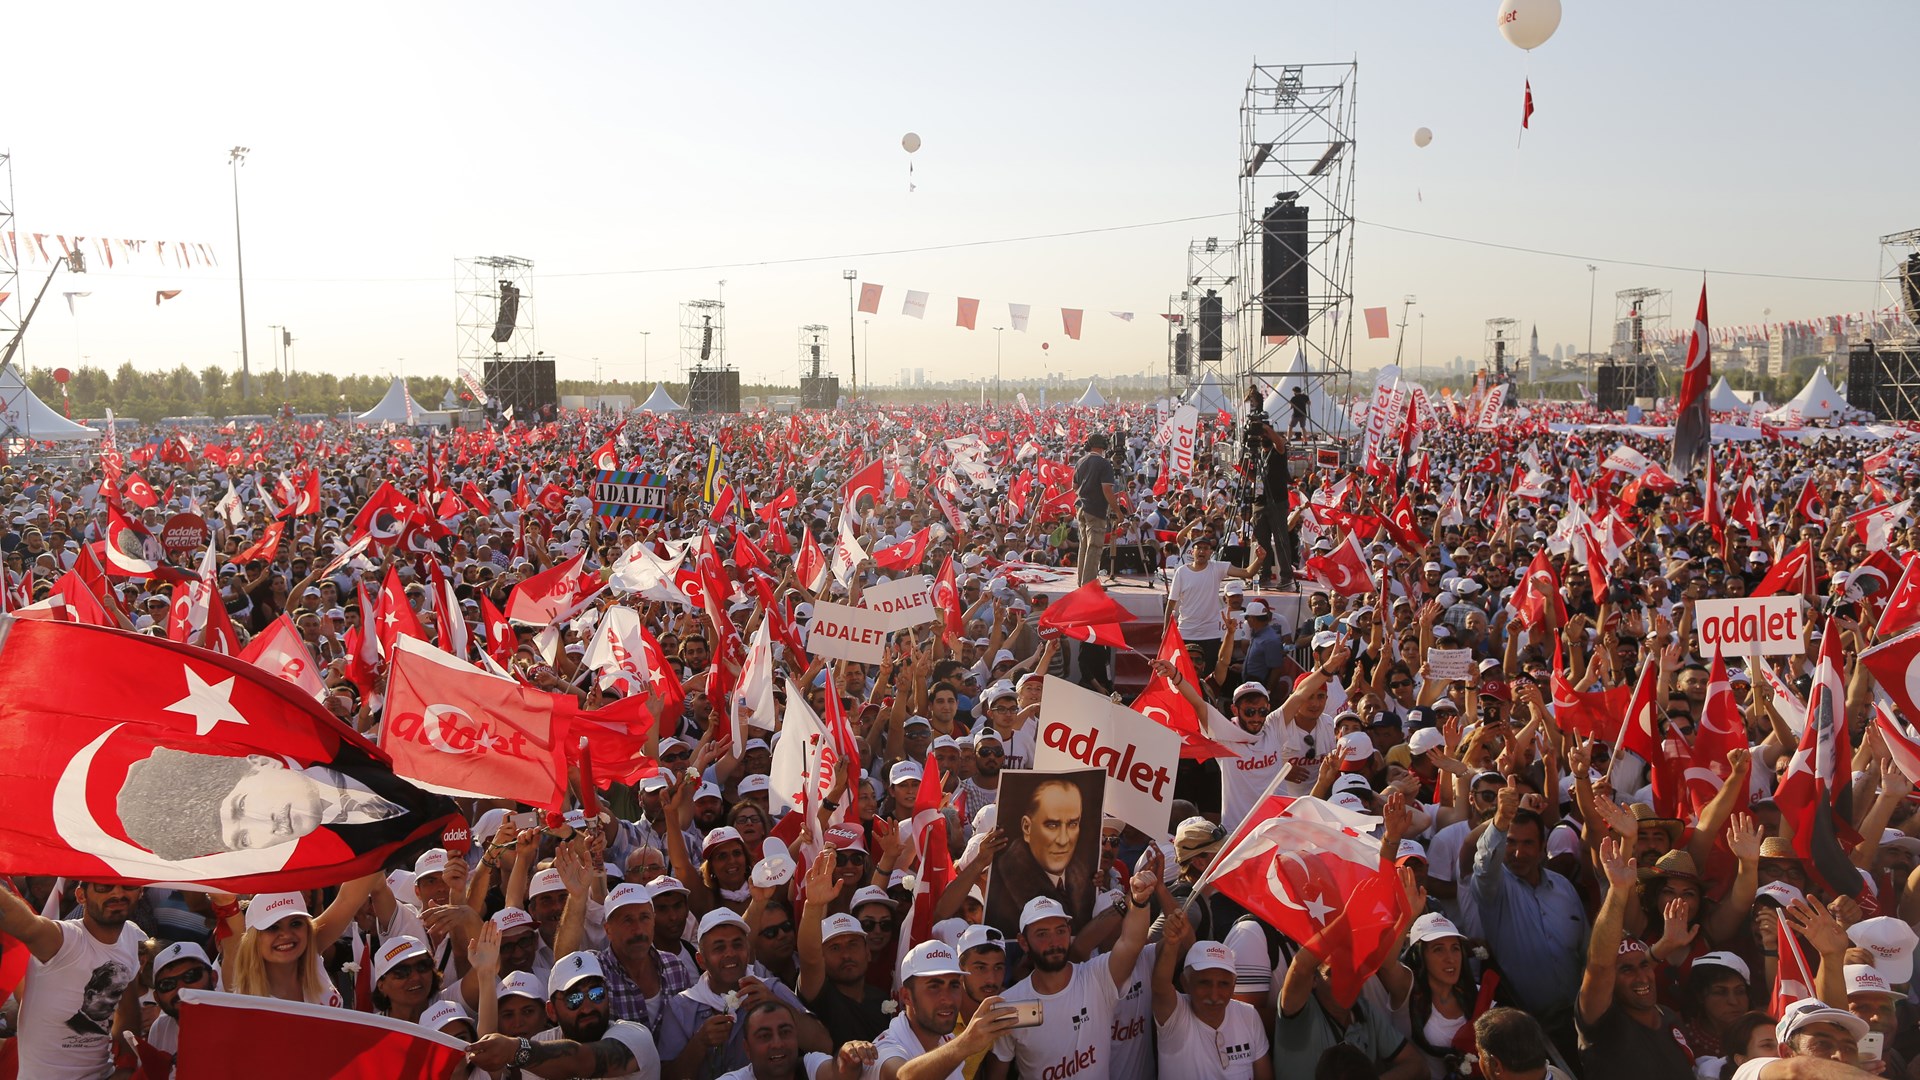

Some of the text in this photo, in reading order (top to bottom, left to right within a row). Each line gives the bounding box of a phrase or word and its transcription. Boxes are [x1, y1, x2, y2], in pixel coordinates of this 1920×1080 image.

[595, 481, 666, 508] ADALET
[168, 526, 203, 537] adalet
[1703, 605, 1798, 644] adalet
[814, 620, 884, 646] ADALET
[390, 711, 527, 757] adalet
[1043, 722, 1171, 803] adalet
[1236, 751, 1278, 771] adalet
[443, 828, 467, 842] adalet
[828, 828, 858, 840] adalet
[542, 873, 560, 881] adalet
[611, 887, 634, 901] adalet
[1764, 884, 1791, 895] adalet
[265, 898, 294, 912] adalet
[502, 911, 525, 921] adalet
[385, 942, 412, 961] tmmob
[926, 949, 952, 960] adalet
[1206, 947, 1226, 955] adalet
[1870, 944, 1901, 954] adalet
[1856, 973, 1884, 984] adalet
[431, 1007, 457, 1021] adalet
[1110, 1015, 1145, 1041] dalet
[1042, 1044, 1097, 1080] adalet
